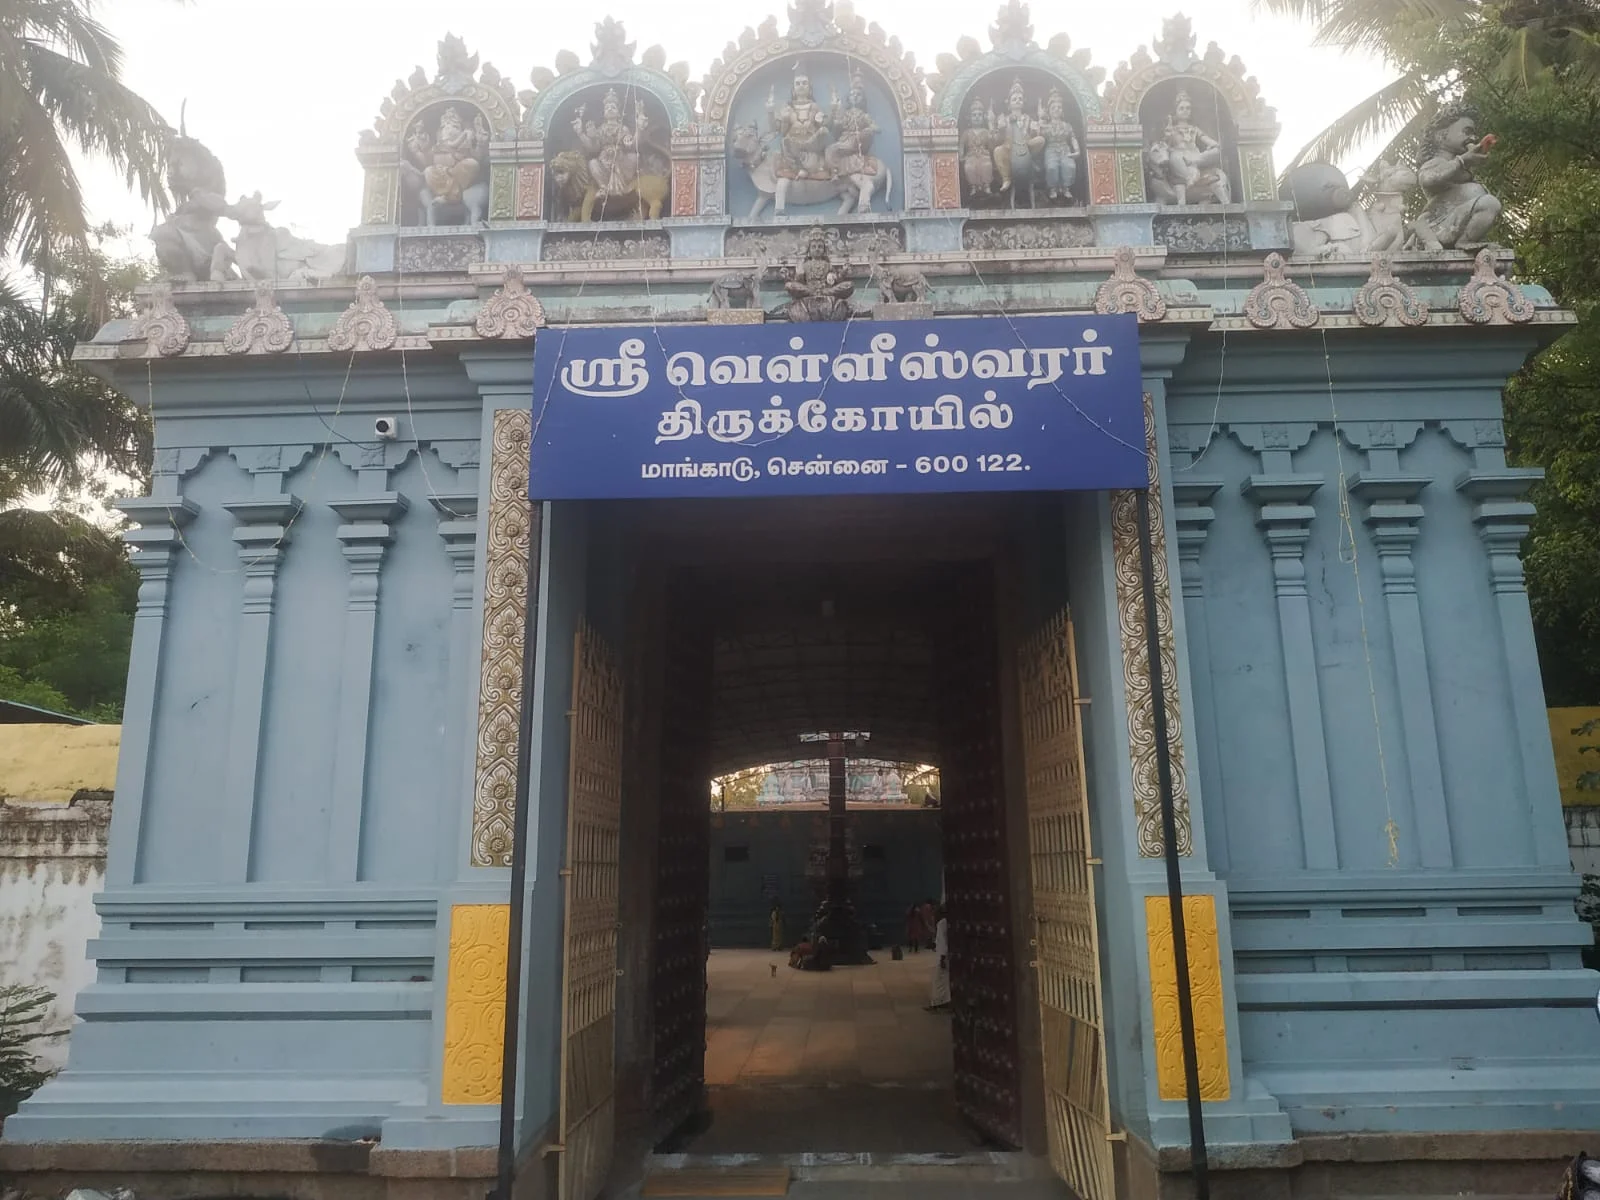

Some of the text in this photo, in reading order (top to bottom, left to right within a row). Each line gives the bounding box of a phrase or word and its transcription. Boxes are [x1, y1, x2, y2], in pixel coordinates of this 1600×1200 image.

[560, 328, 1113, 398] ஸ்ரீ வெள்ளீஸ்வரர்
[654, 390, 1014, 445] திருக்கோயில்
[641, 456, 762, 482] மாங்காடு,
[767, 454, 889, 477] சென்னை
[915, 455, 969, 474] 600
[975, 453, 1032, 472] 122.
